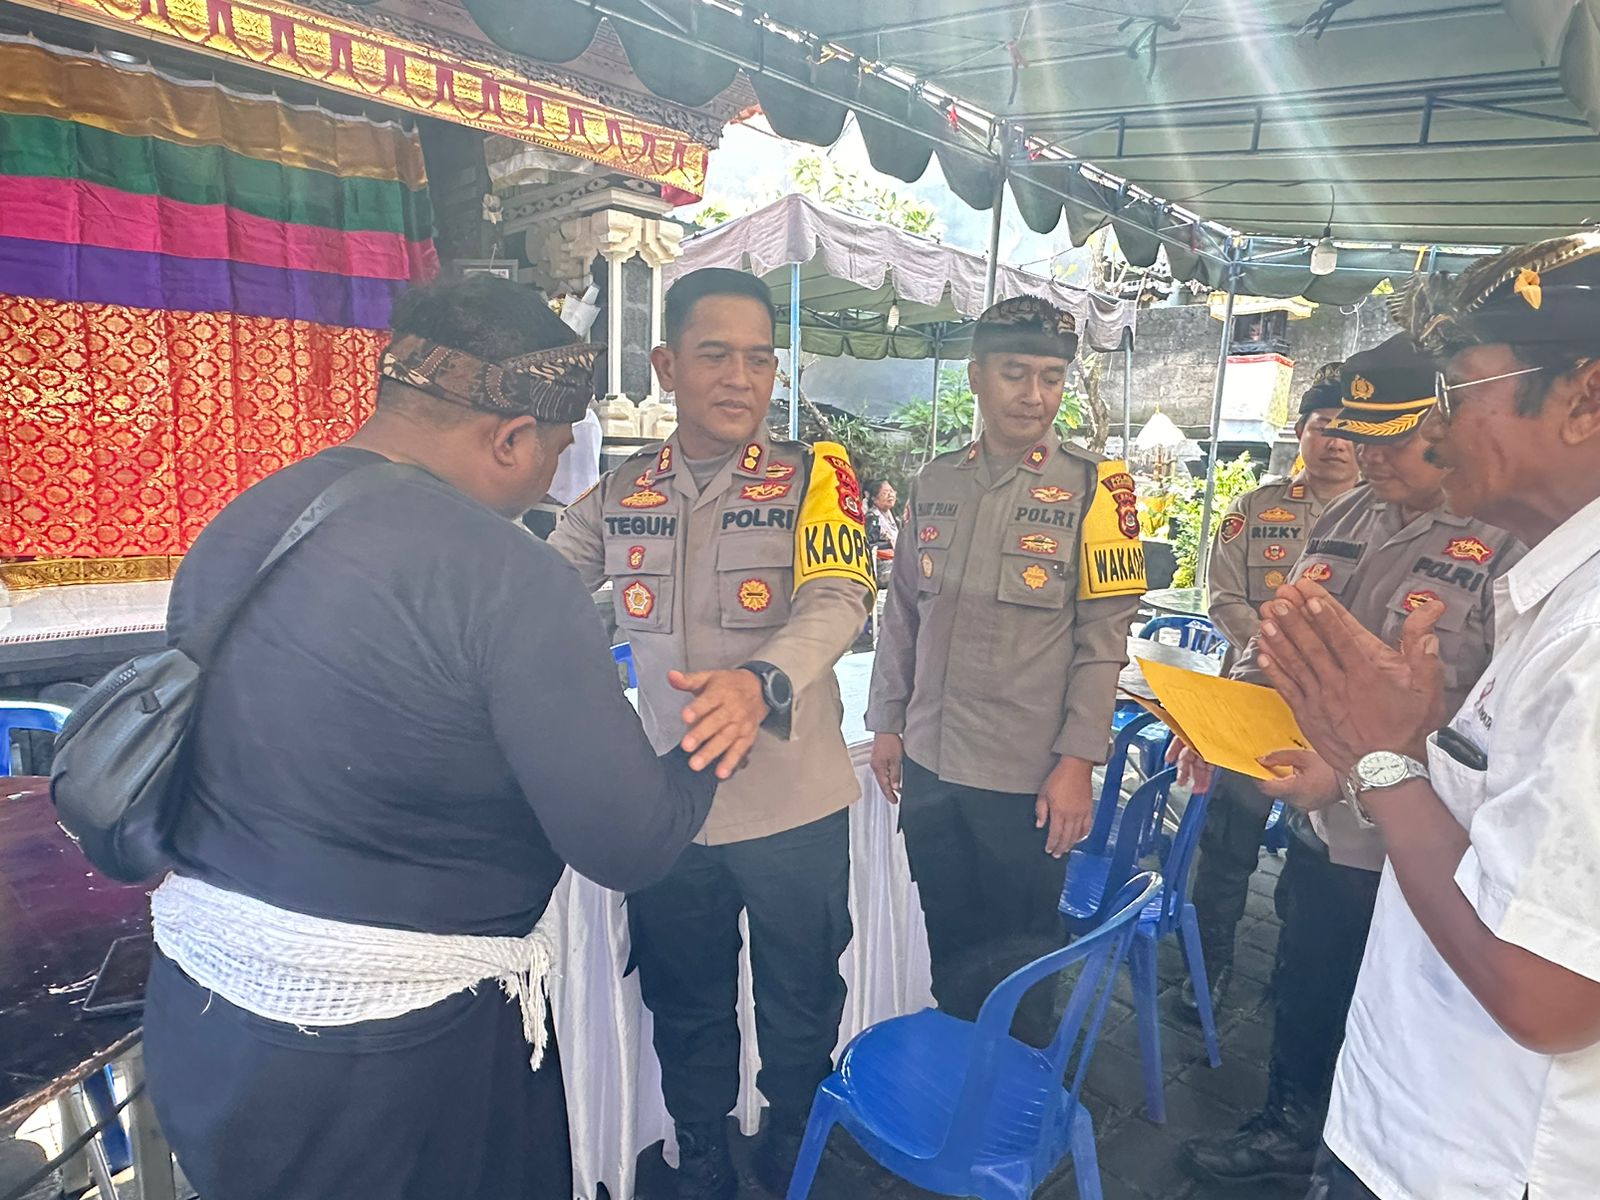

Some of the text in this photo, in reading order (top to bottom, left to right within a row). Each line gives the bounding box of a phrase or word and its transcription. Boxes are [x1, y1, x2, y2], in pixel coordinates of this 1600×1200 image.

[604, 516, 676, 537] TEGUH
[722, 508, 794, 531] POLRI
[1014, 506, 1076, 529] POLRI
[1251, 526, 1301, 539] RIZKY
[1412, 556, 1485, 592] POLRI
